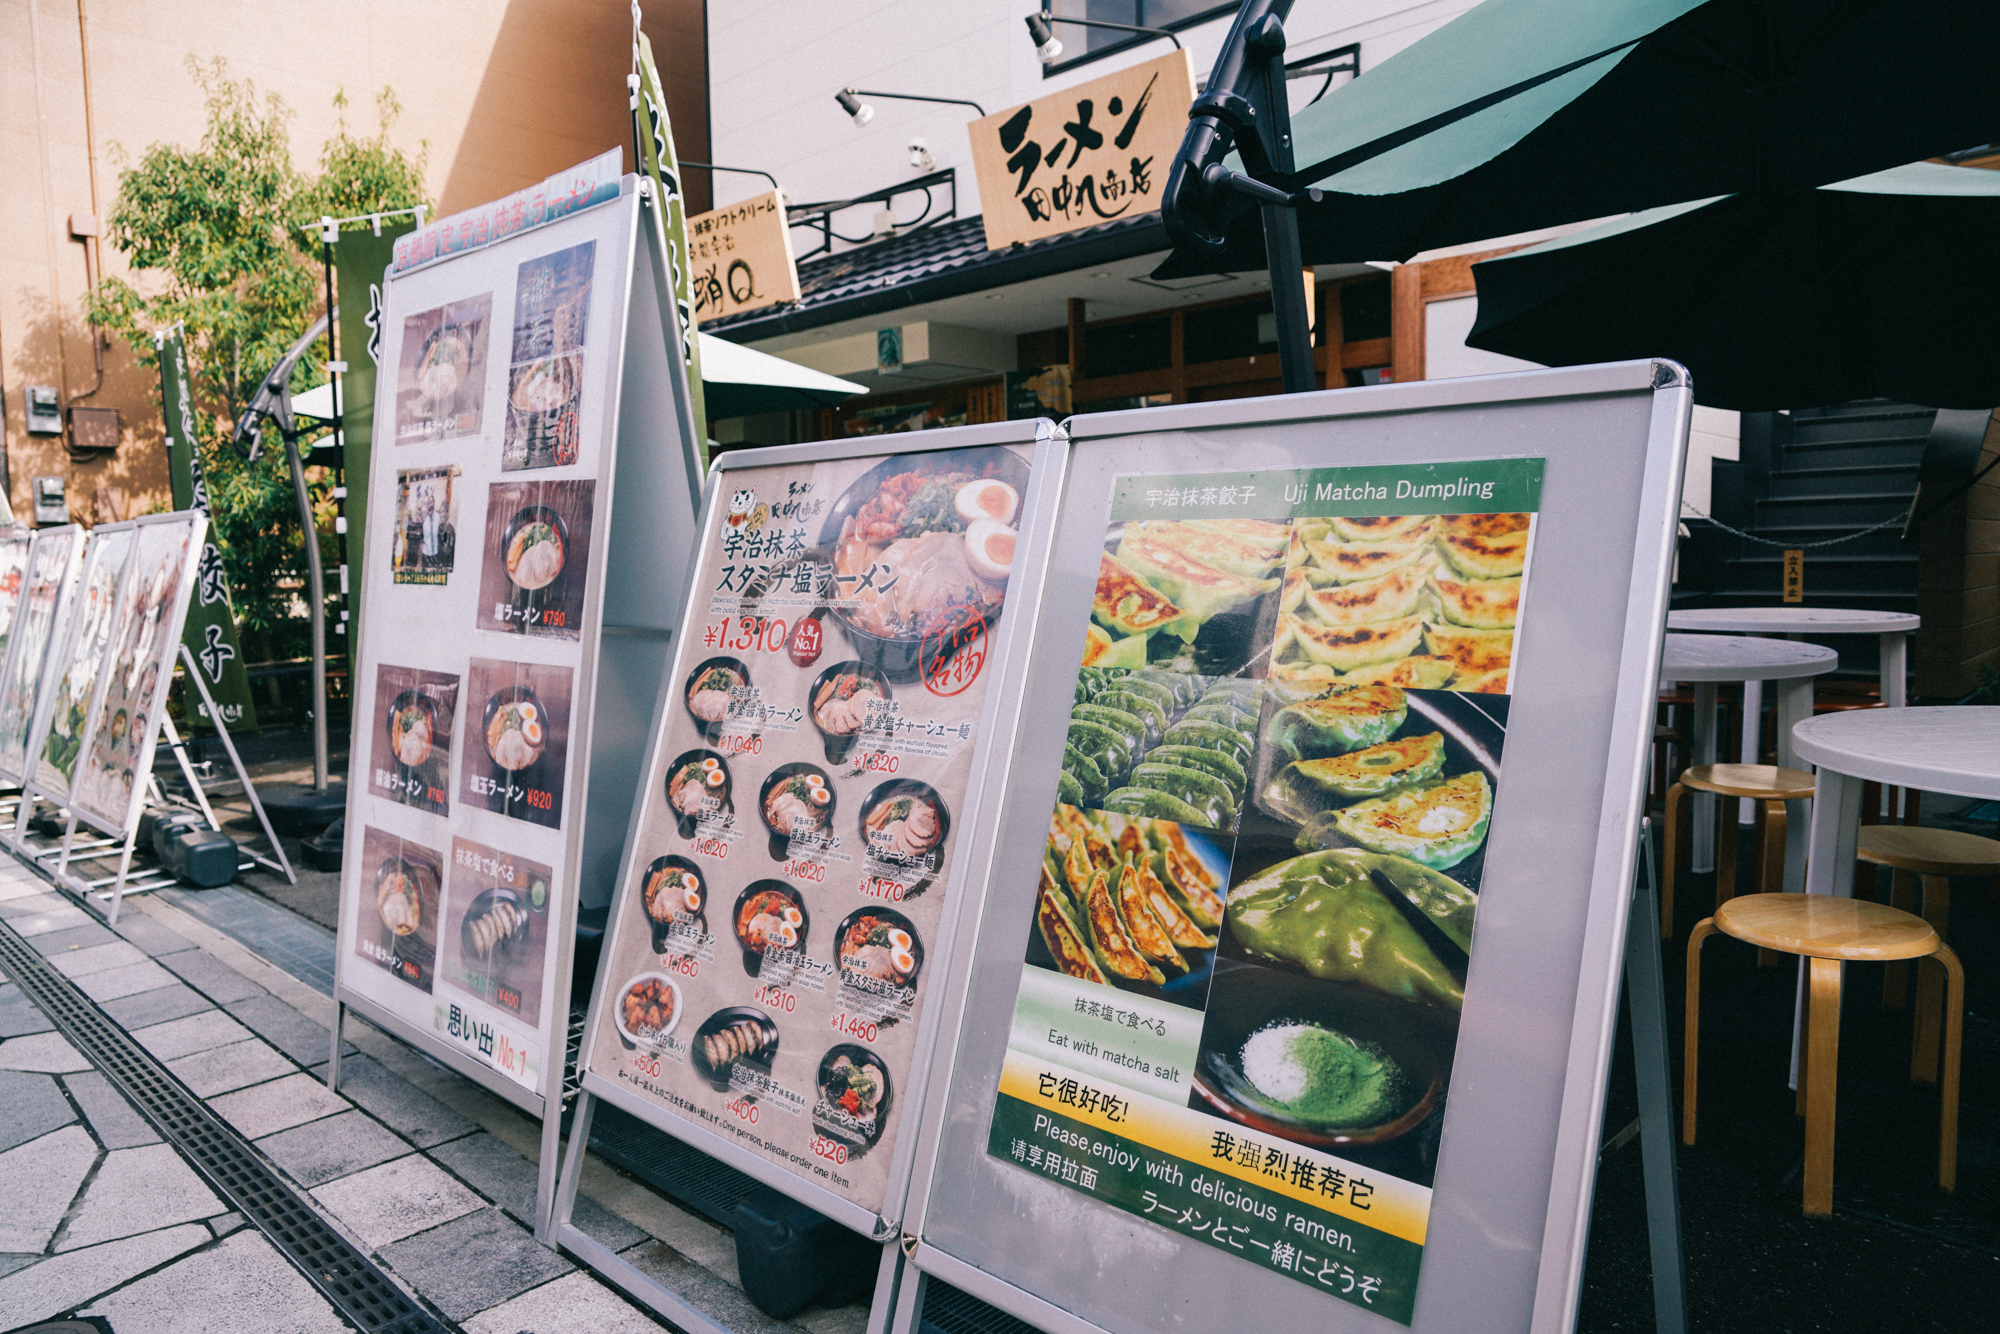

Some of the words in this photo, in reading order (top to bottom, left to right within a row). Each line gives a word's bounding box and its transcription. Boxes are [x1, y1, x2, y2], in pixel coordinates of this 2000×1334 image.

[998, 71, 1159, 198] ラーメン
[788, 480, 818, 498] ラーメン
[1145, 485, 1257, 508] 宇治抹茶餃子
[1283, 482, 1309, 503] Uji
[1314, 480, 1388, 502] Matcha
[1395, 477, 1495, 502] Dumpling
[723, 527, 807, 560] 宇治抹茶
[715, 562, 901, 595] スタミナ塩ラーメン
[1787, 555, 1799, 598] 立入禁止
[494, 602, 541, 624] 塩ラーメン
[542, 609, 566, 627] ¥790
[703, 616, 787, 652] ¥1,310
[793, 632, 819, 651] No.1
[797, 624, 815, 638] 人気
[730, 686, 760, 700] 宇治抹茶
[866, 699, 900, 713] 宇治抹茶
[726, 700, 804, 722] 黄金醤油ラーメン
[862, 714, 972, 740] 黄金塩チャーシュー麺
[719, 734, 763, 755] ¥1,040
[853, 752, 900, 774] ¥1,320
[469, 773, 525, 803] 塩玉ラーメン
[526, 787, 552, 810] ¥920
[690, 837, 728, 858] ¥1,020
[790, 828, 842, 848] 醤油玉ラーメン
[455, 846, 515, 883] 抹茶塩で食べる
[783, 859, 826, 882] ¥1,020
[866, 844, 934, 870] 塩チャーシュー麺
[859, 877, 904, 902] ¥1,170
[661, 953, 699, 977] ¥1,160
[842, 955, 868, 969] 宇治抹茶
[498, 987, 520, 1009] ¥400
[754, 986, 796, 1012] ¥1,310
[839, 968, 916, 1002] 黄金スタミナ塩ラーメン
[831, 1013, 877, 1042] ¥1,460
[1073, 995, 1167, 1037] 抹茶塩で食べる
[446, 1003, 494, 1058] 思い出
[497, 1034, 515, 1072] No.
[518, 1050, 526, 1077] 1
[638, 1023, 686, 1053] からあげ5個入り
[633, 1054, 661, 1078] ¥500
[1047, 1028, 1070, 1046] Eat
[1072, 1037, 1099, 1058] with
[1101, 1045, 1150, 1074] matcha
[1154, 1061, 1181, 1084] salt
[732, 1064, 779, 1094] 宇治抹茶餃子
[725, 1098, 760, 1124] ¥400
[1038, 1072, 1129, 1124] 它很好吃!
[816, 1100, 875, 1137] チャーシュー丼
[736, 1125, 763, 1148] person,
[764, 1140, 790, 1159] please
[790, 1152, 813, 1172] order
[813, 1164, 829, 1179] one
[830, 1171, 850, 1189] item
[808, 1135, 847, 1165] ¥520
[1010, 1137, 1098, 1192] 请享用拉面
[1210, 1129, 1375, 1211] 我强烈推荐它
[1144, 1158, 1185, 1188] with
[1190, 1172, 1278, 1223] delicious
[1284, 1209, 1358, 1254] ramen.
[1141, 1189, 1383, 1306] ラーメンとご一緒にどうぞ
